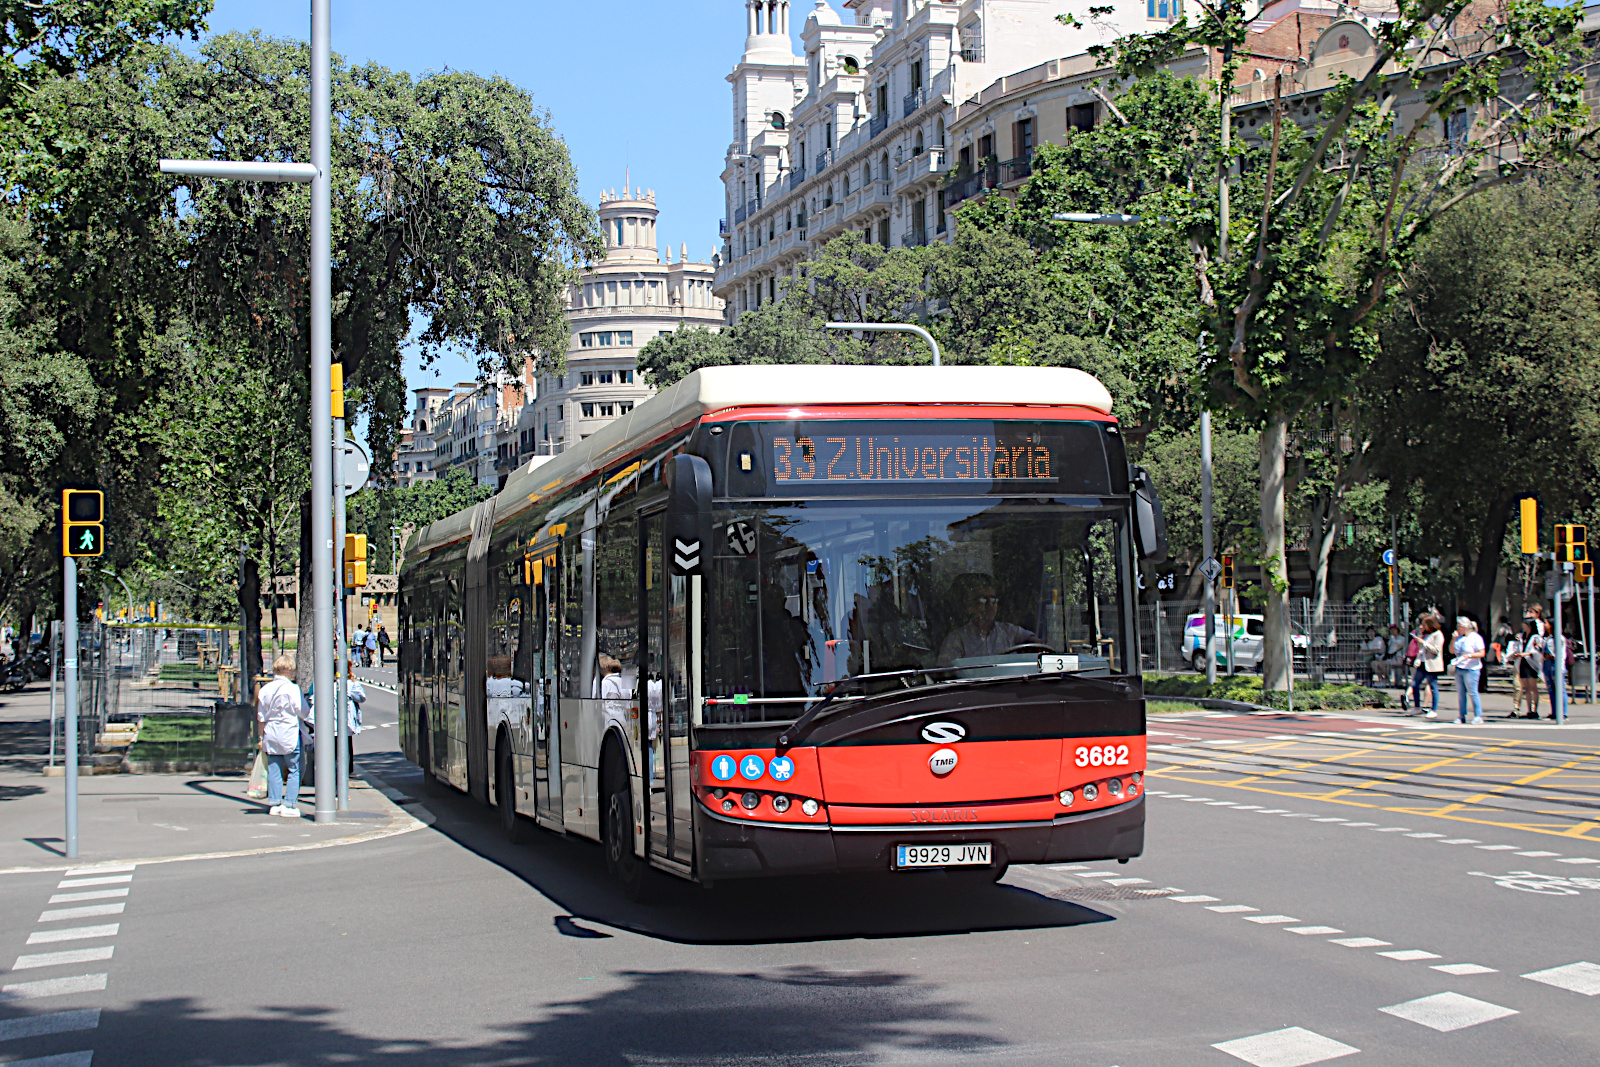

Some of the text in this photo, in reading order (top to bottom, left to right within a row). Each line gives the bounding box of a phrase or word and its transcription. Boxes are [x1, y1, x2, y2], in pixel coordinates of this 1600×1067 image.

[774, 437, 815, 480] 33
[1056, 658, 1064, 670] 3
[935, 758, 954, 766] TMB
[1075, 745, 1129, 767] 3682
[909, 809, 978, 822] SOLARIS
[909, 846, 987, 863] 9929 JVN
